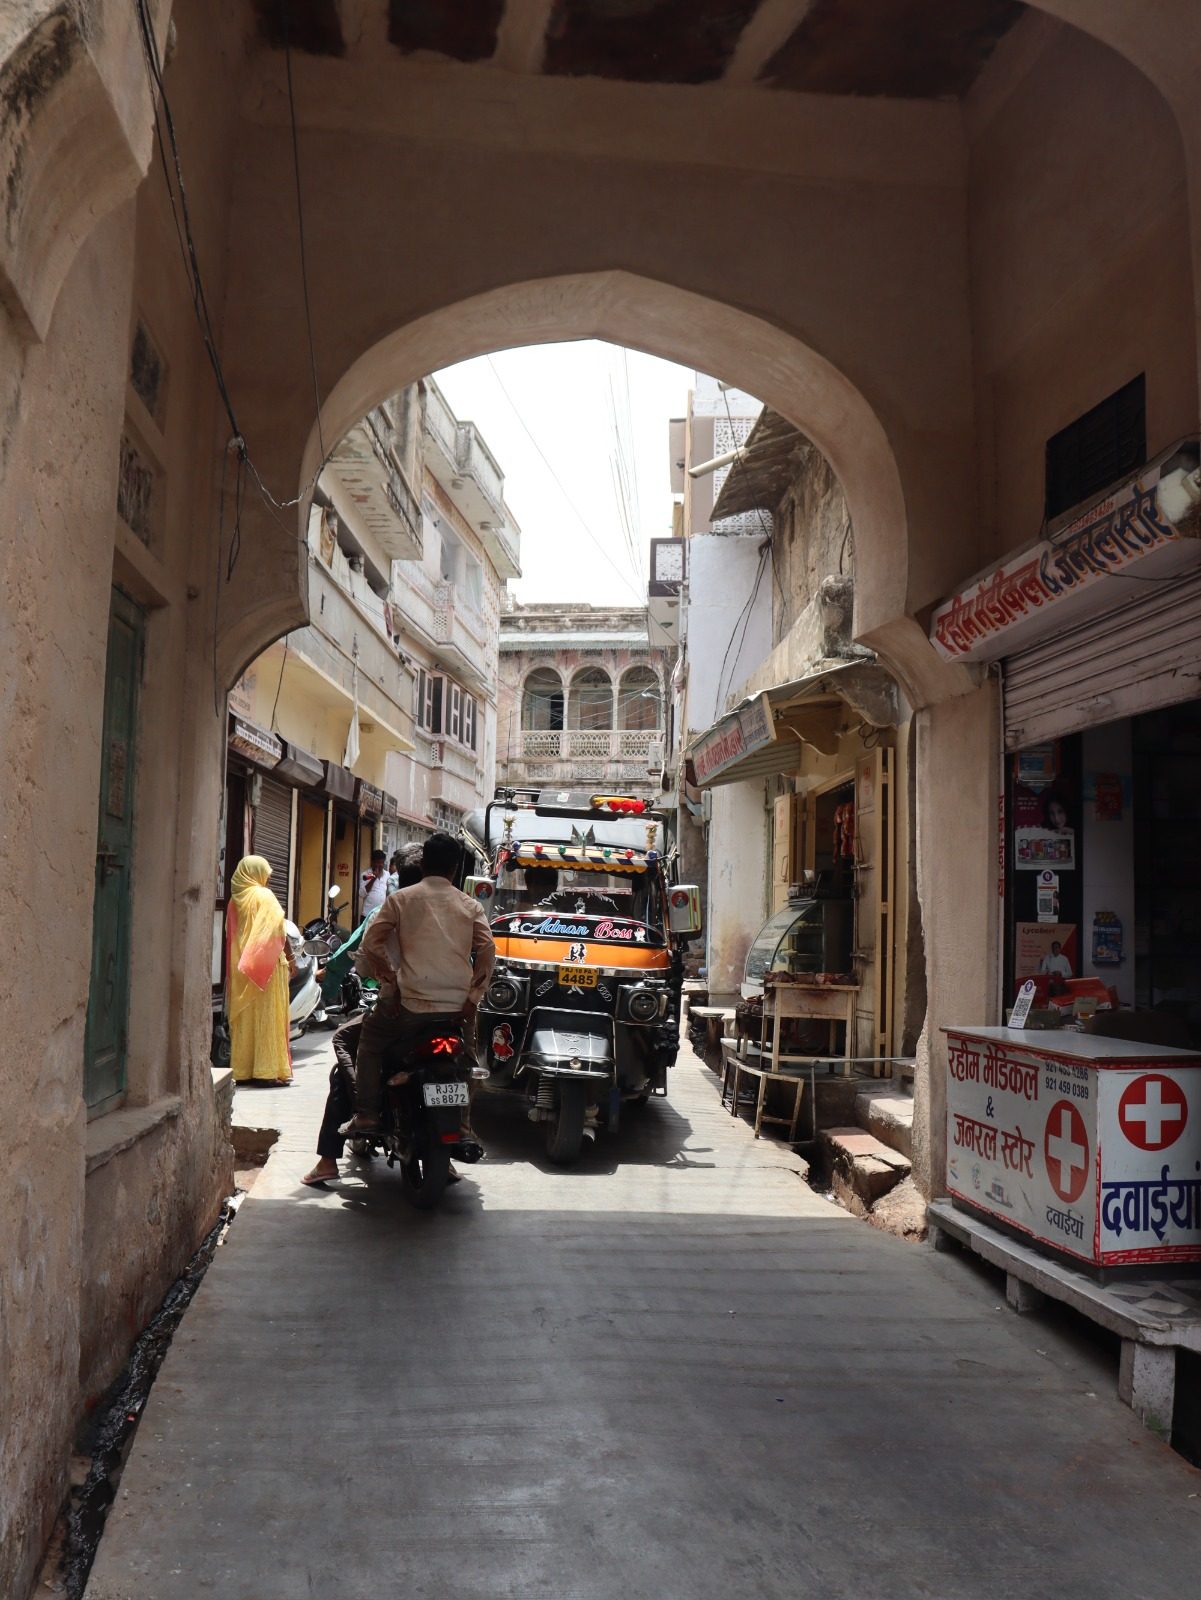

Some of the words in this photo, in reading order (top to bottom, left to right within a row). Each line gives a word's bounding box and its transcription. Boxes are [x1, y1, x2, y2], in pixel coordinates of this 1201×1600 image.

[1054, 511, 1128, 585] जनरल
[520, 917, 589, 936] Adnan
[593, 922, 633, 939] Boss
[562, 973, 594, 985] 4485
[948, 1041, 981, 1083] रहीम
[983, 1044, 1040, 1101] मेडिकल
[436, 1084, 459, 1094] RJ37
[442, 1094, 466, 1104] 8872
[1045, 1076, 1057, 1091] 921
[1058, 1080, 1071, 1094] 459
[1072, 1083, 1089, 1099] 0389
[986, 1096, 994, 1118] &
[953, 1113, 998, 1161] जनरल
[1001, 1125, 1036, 1179] स्टोर
[1101, 1160, 1201, 1241] दवाईयां
[1046, 1205, 1085, 1240] दवाईयां
